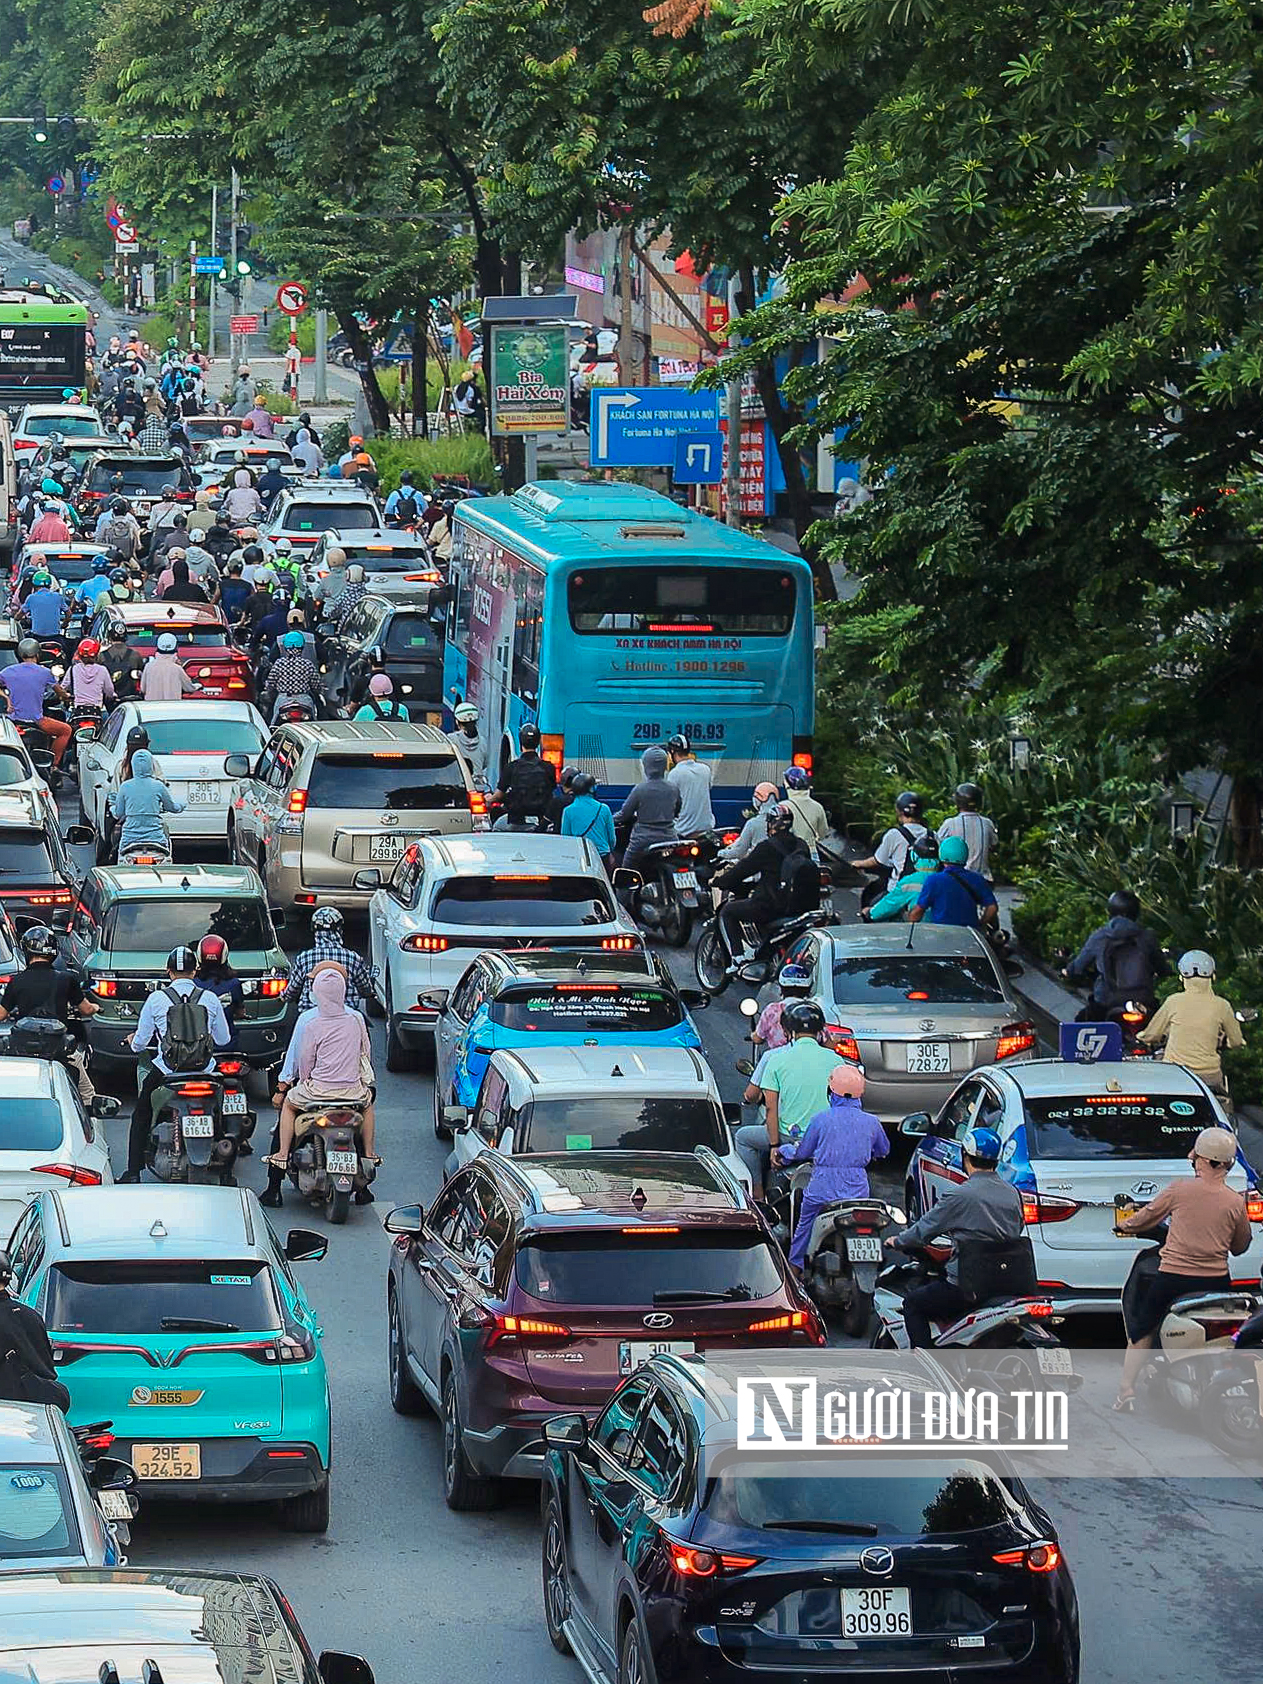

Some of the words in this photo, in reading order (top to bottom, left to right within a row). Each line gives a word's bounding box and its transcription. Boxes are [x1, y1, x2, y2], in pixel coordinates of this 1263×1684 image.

[516, 370, 544, 385] Bia
[633, 723, 661, 740] 29B
[676, 724, 726, 740] 186.93
[197, 783, 212, 793] 30E
[379, 838, 397, 848] 29A
[1076, 1028, 1108, 1059] G7
[916, 1044, 940, 1058] 30E
[908, 1058, 950, 1072] 728.27
[224, 1094, 243, 1104] 9-E2
[224, 1104, 246, 1113] 81.43
[155, 1392, 182, 1404] 1555
[151, 1447, 180, 1462] 29E
[139, 1462, 193, 1478] 324.52
[857, 1590, 894, 1611] 30F
[845, 1612, 910, 1634] 309.96
